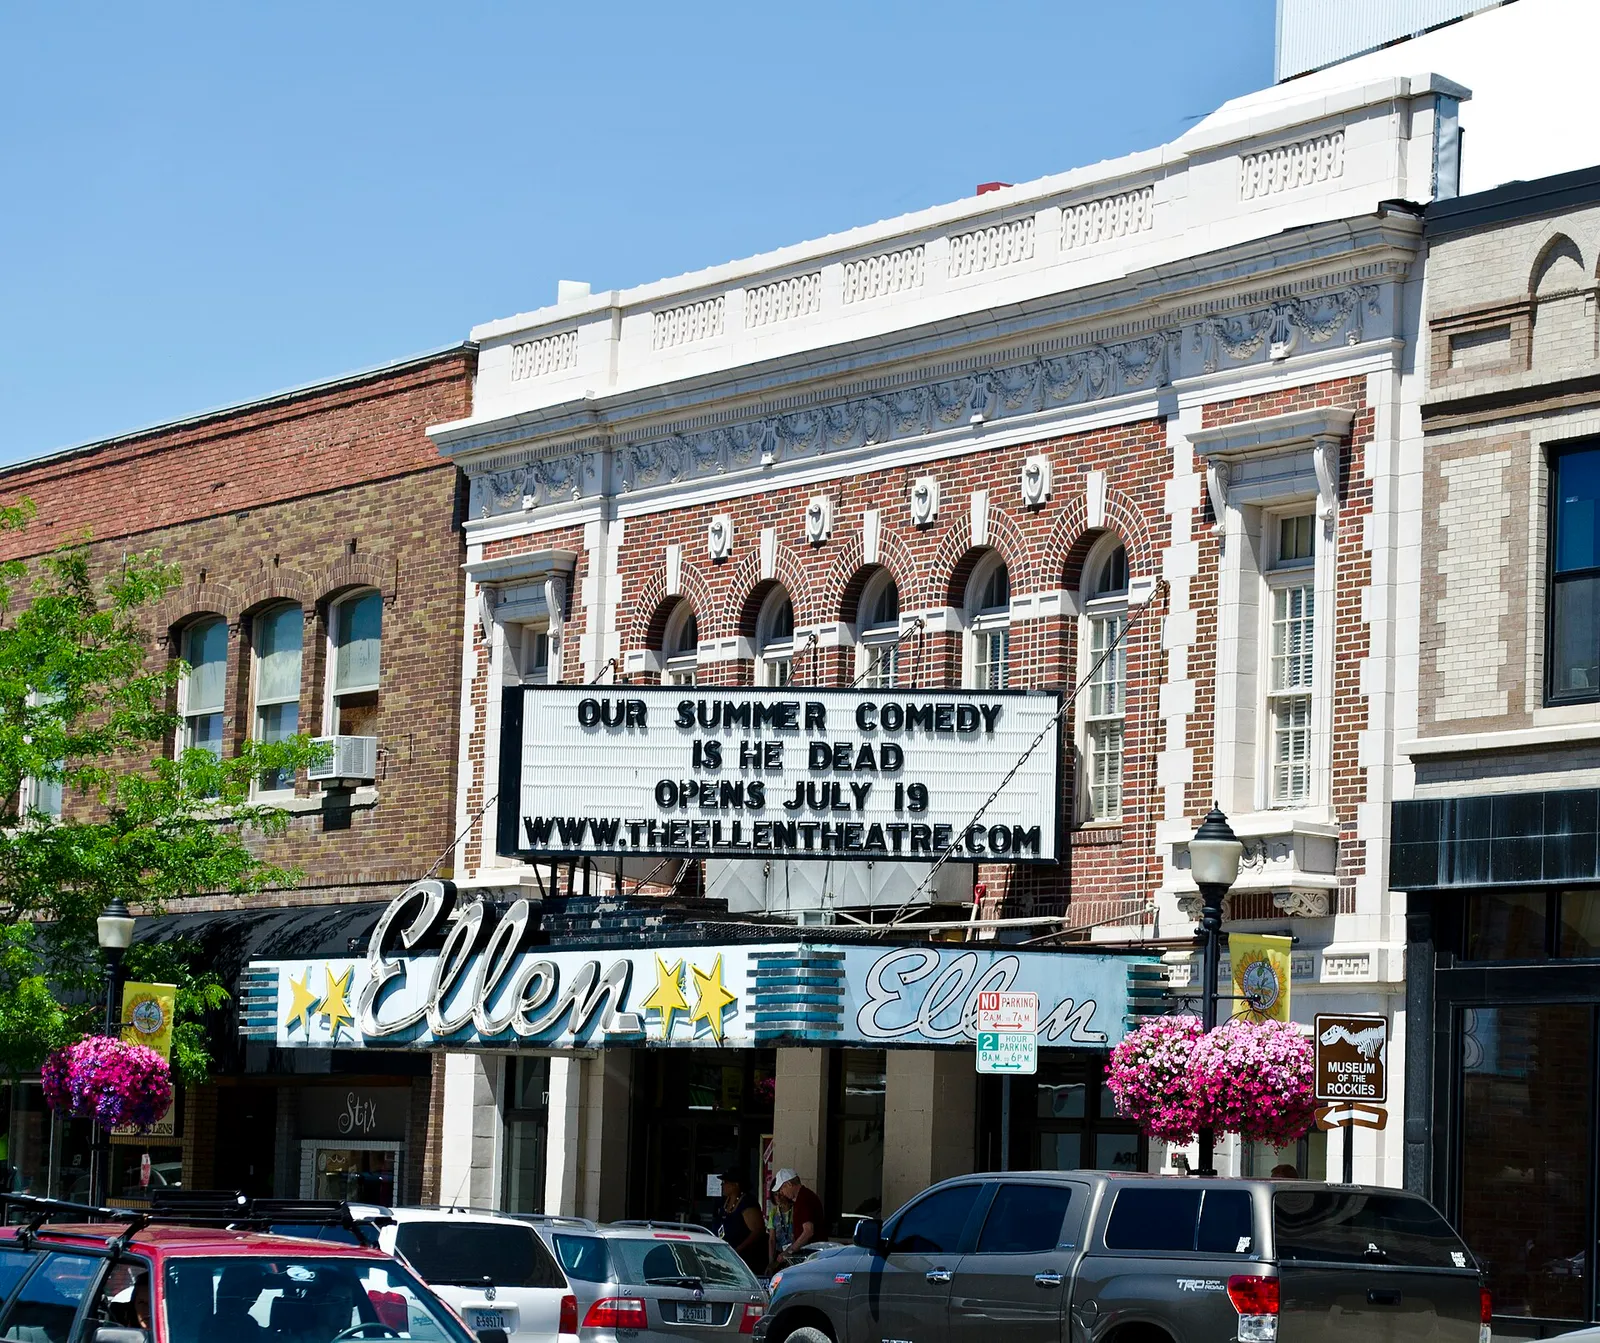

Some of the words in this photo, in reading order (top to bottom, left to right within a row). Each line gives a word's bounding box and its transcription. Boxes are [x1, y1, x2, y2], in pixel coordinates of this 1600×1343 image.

[578, 698, 647, 728] OUR
[676, 700, 826, 731] SUMMER
[855, 702, 1002, 733] COMEDY
[692, 740, 722, 769] IS
[740, 740, 783, 770] HE
[809, 742, 904, 773] DEAD
[654, 779, 765, 810] OPENS
[783, 781, 872, 812] JULY
[895, 782, 929, 813] 19
[523, 816, 1041, 854] WWW.THEELLENTHEATRE.COM
[359, 878, 646, 1037] Ellen
[856, 946, 1108, 1043] Elln
[981, 994, 998, 1010] NO
[1001, 997, 1034, 1008] PARKING
[983, 1034, 993, 1050] 2
[1000, 1043, 1033, 1052] PARKING
[1327, 1062, 1376, 1074] MUSEUM
[1352, 1075, 1366, 1083] THE
[1327, 1083, 1376, 1095] ROCKIES
[338, 1091, 377, 1134] Stix
[1176, 1279, 1205, 1291] TRD
